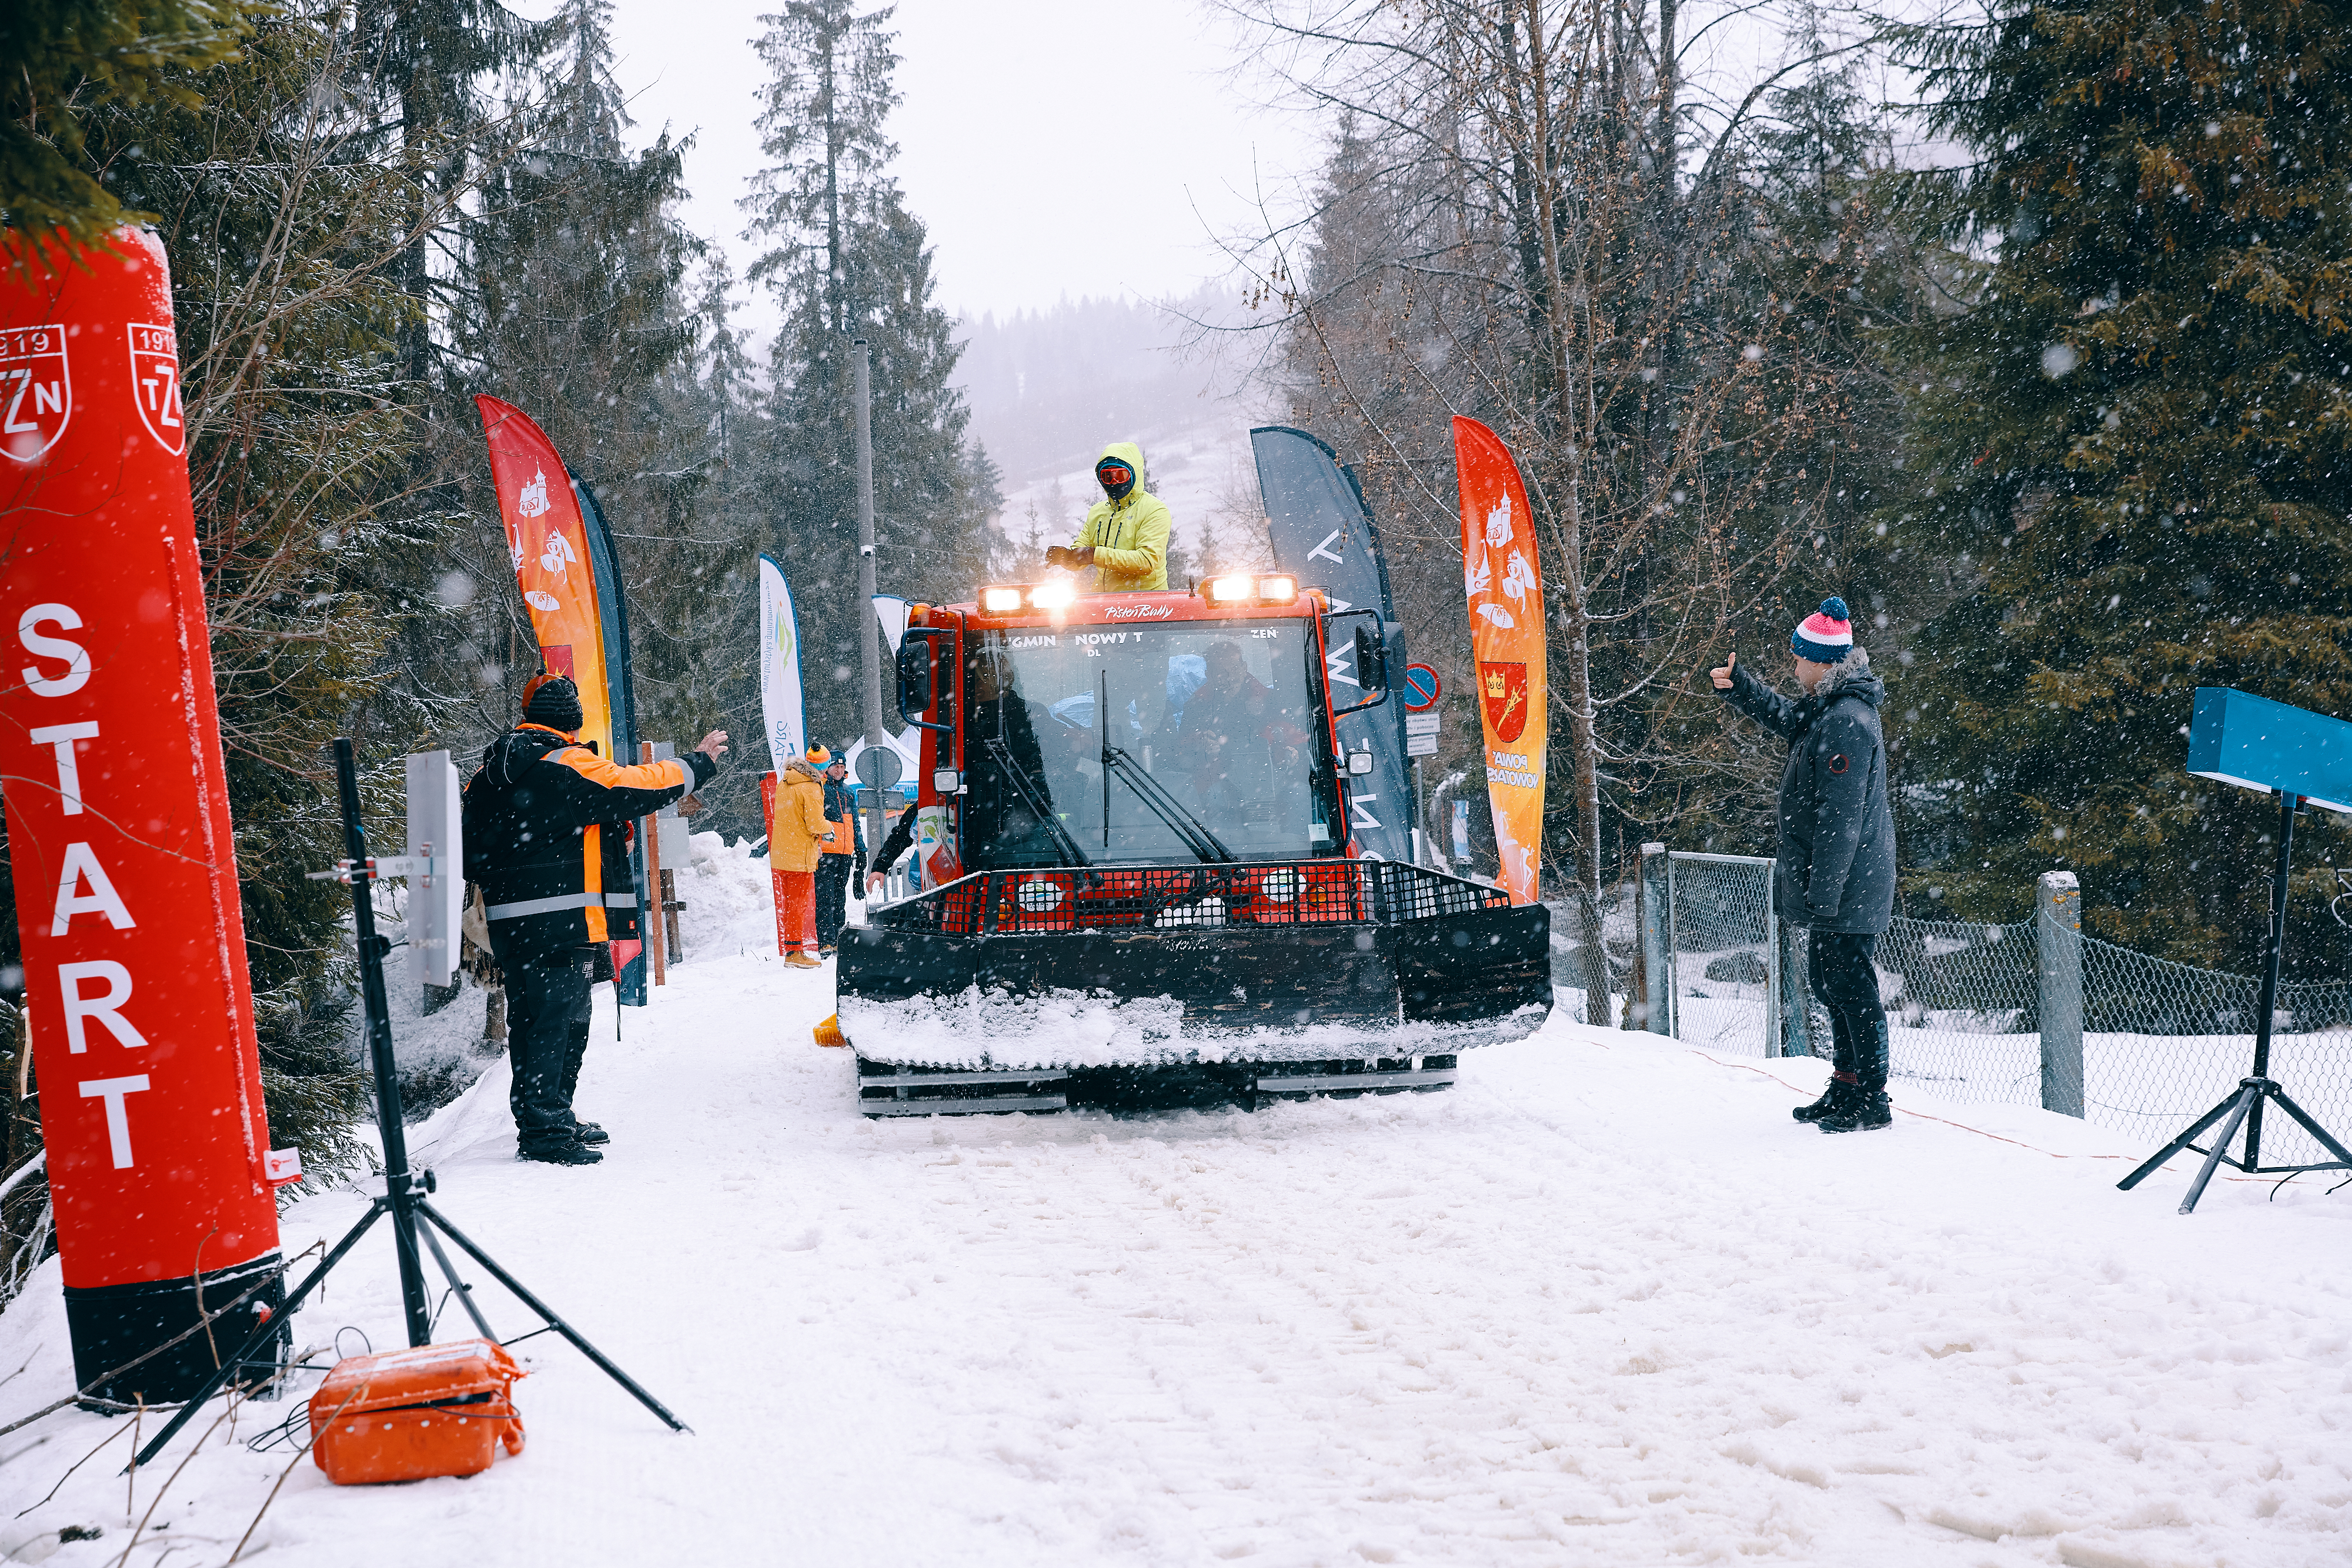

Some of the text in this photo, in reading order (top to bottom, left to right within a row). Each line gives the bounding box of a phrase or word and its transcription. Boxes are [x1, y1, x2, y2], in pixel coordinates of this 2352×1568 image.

[139, 330, 176, 352] 191
[1104, 604, 1174, 620] PistenBully
[1075, 632, 1127, 646] NOWY
[1133, 631, 1143, 643] T
[1087, 649, 1101, 657] DL
[18, 602, 151, 1169] START
